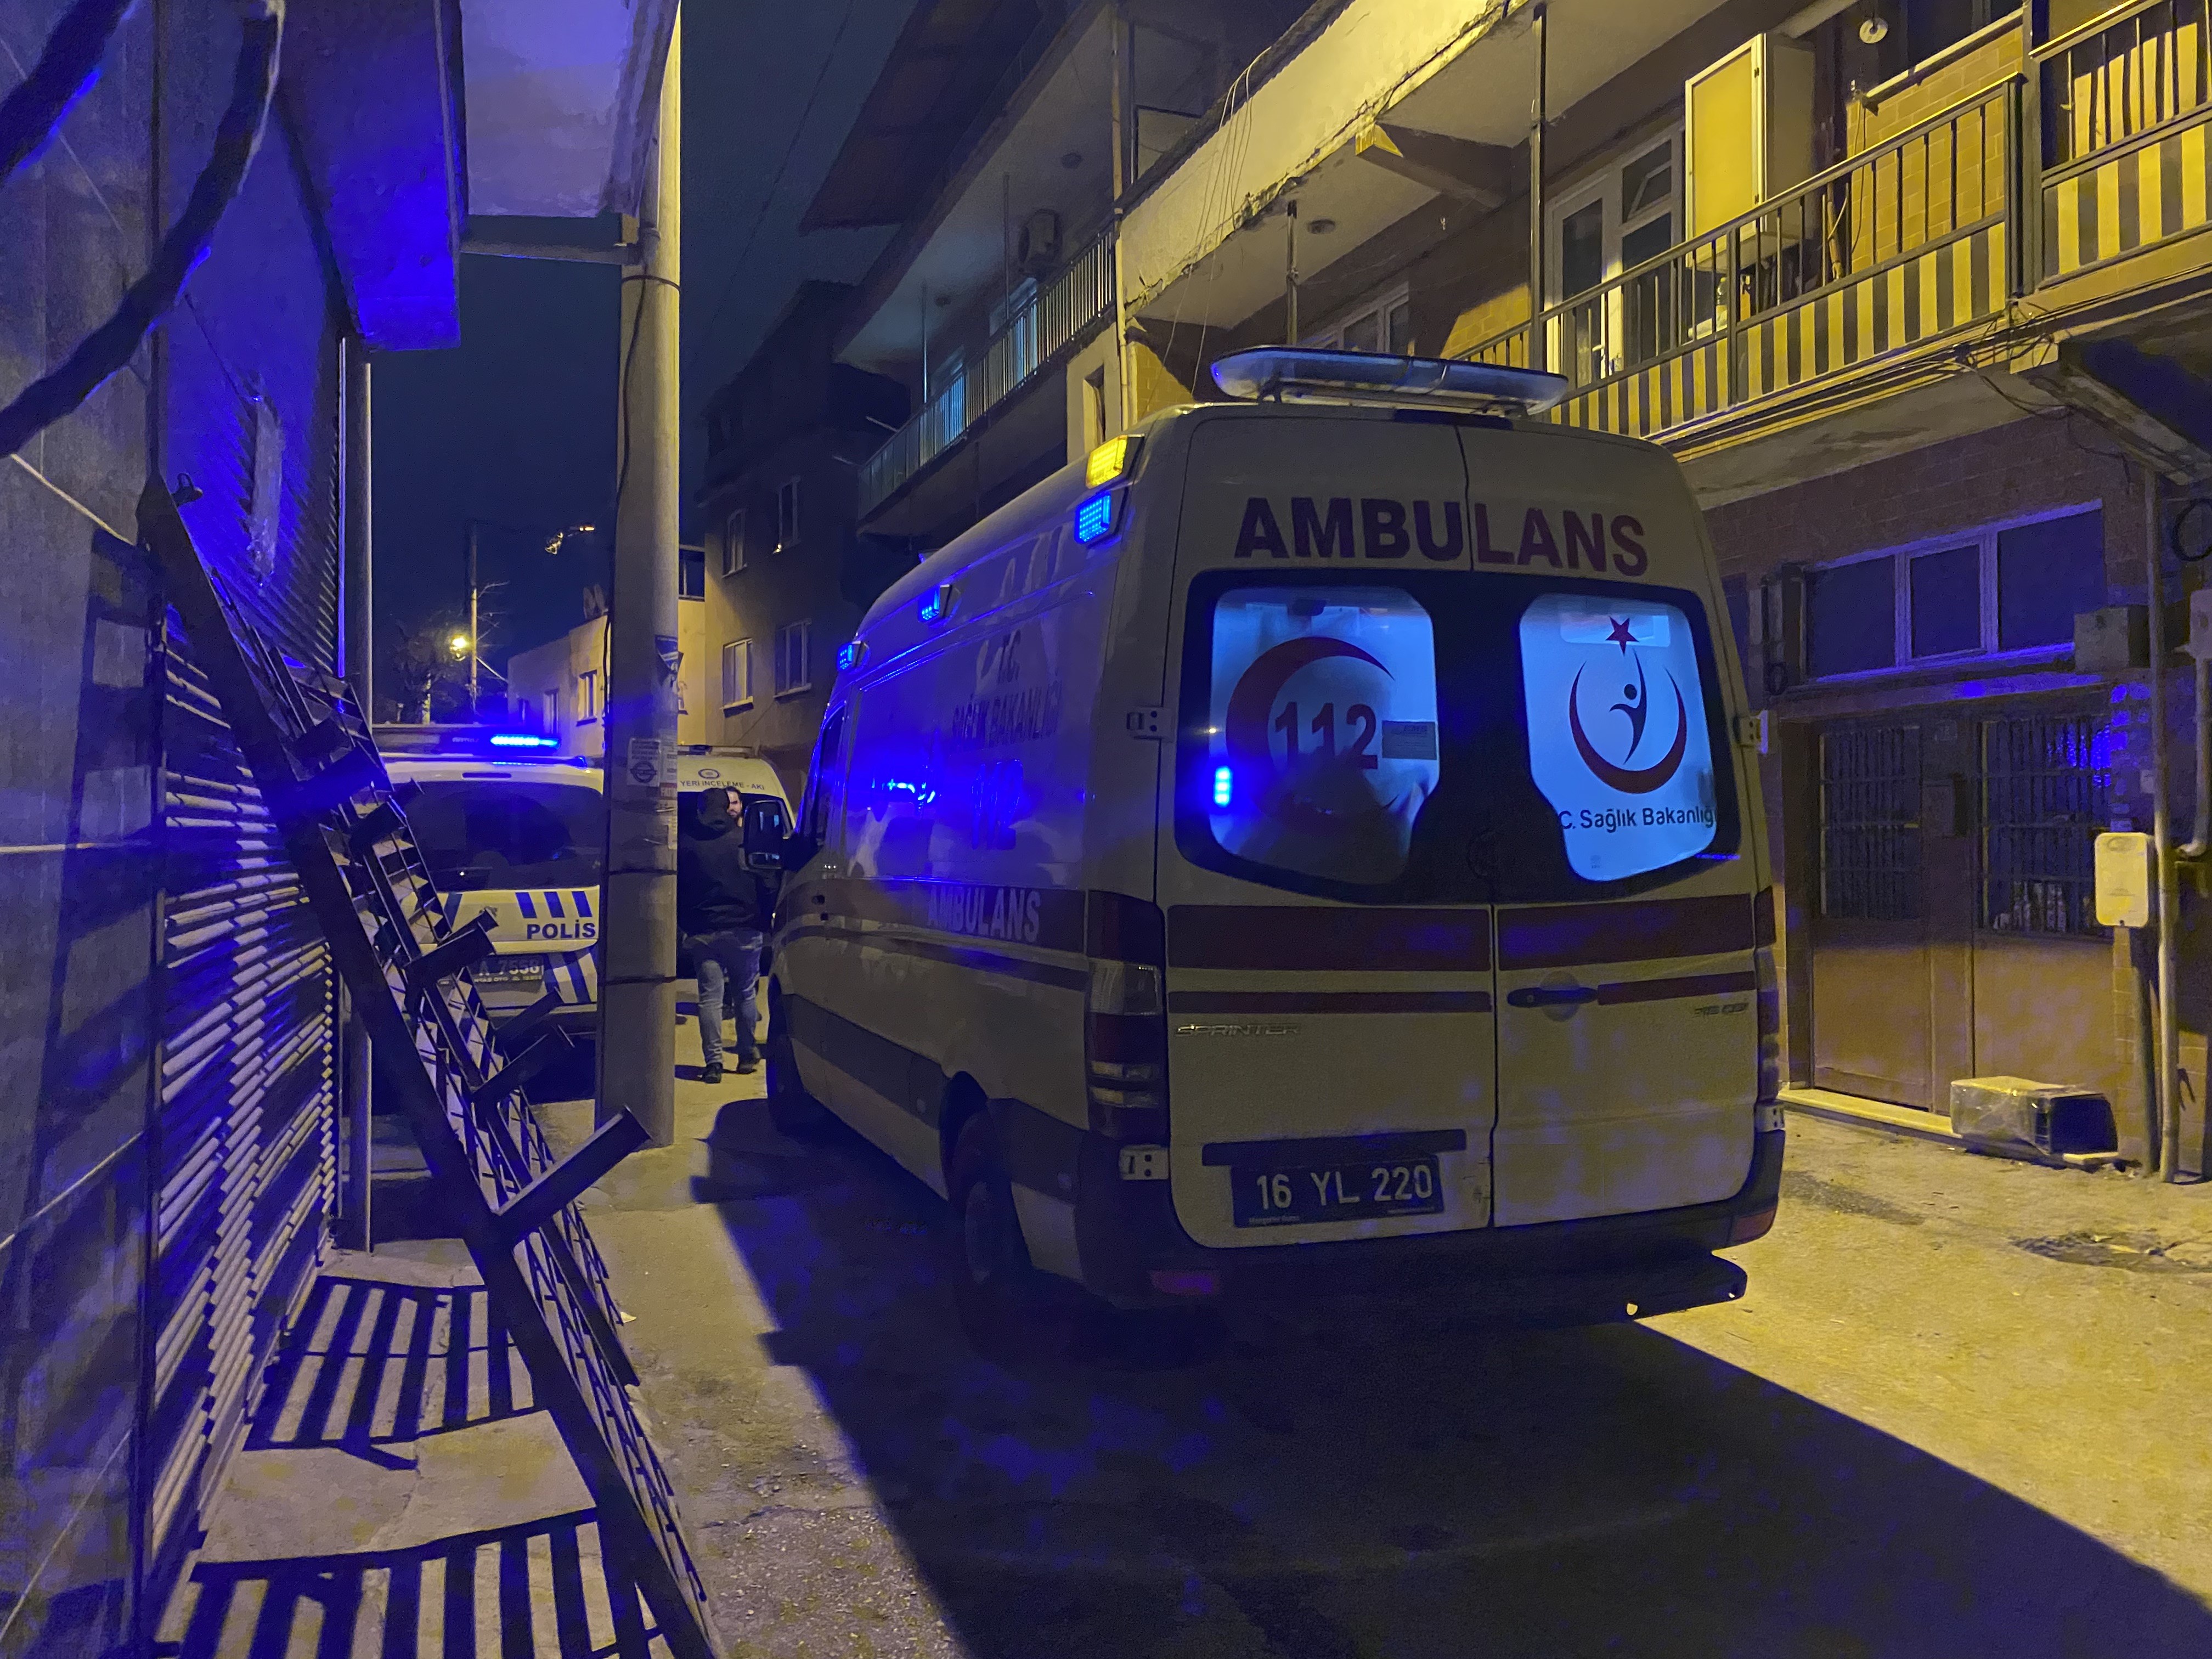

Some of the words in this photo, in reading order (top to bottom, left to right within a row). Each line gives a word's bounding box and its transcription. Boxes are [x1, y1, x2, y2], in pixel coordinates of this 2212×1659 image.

[1233, 496, 1647, 577] AMBULANS
[1275, 701, 1378, 769] 112
[1580, 808, 1637, 833] Sağlık
[527, 919, 596, 939] POLİS
[927, 884, 1041, 943] AMBULANS
[1175, 1024, 1301, 1038] SPRINTER
[1256, 1173, 1293, 1210] 16
[1310, 1171, 1360, 1206] YL
[1372, 1165, 1433, 1202] 220
